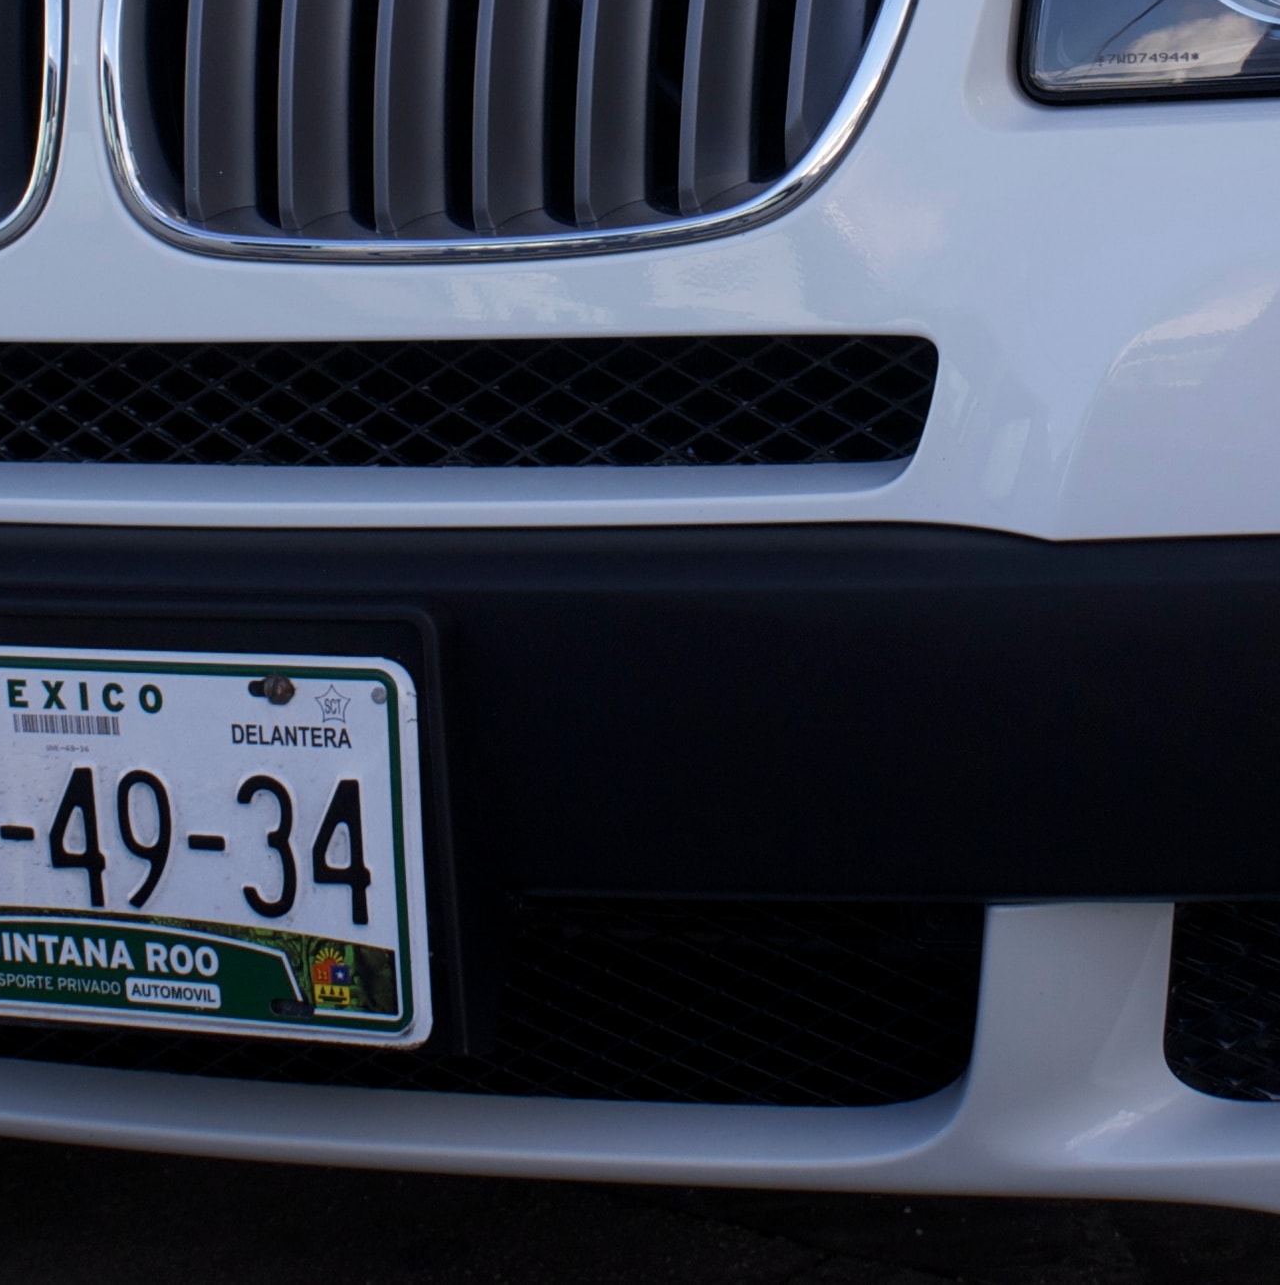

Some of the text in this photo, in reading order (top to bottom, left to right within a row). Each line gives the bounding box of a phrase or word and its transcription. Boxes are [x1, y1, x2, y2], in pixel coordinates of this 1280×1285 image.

[324, 698, 342, 715] SCT
[232, 724, 352, 749] DELANTERA
[145, 942, 219, 977] ROO
[58, 977, 121, 995] PRIVADO
[131, 983, 216, 1003] AUTOMOVIL
